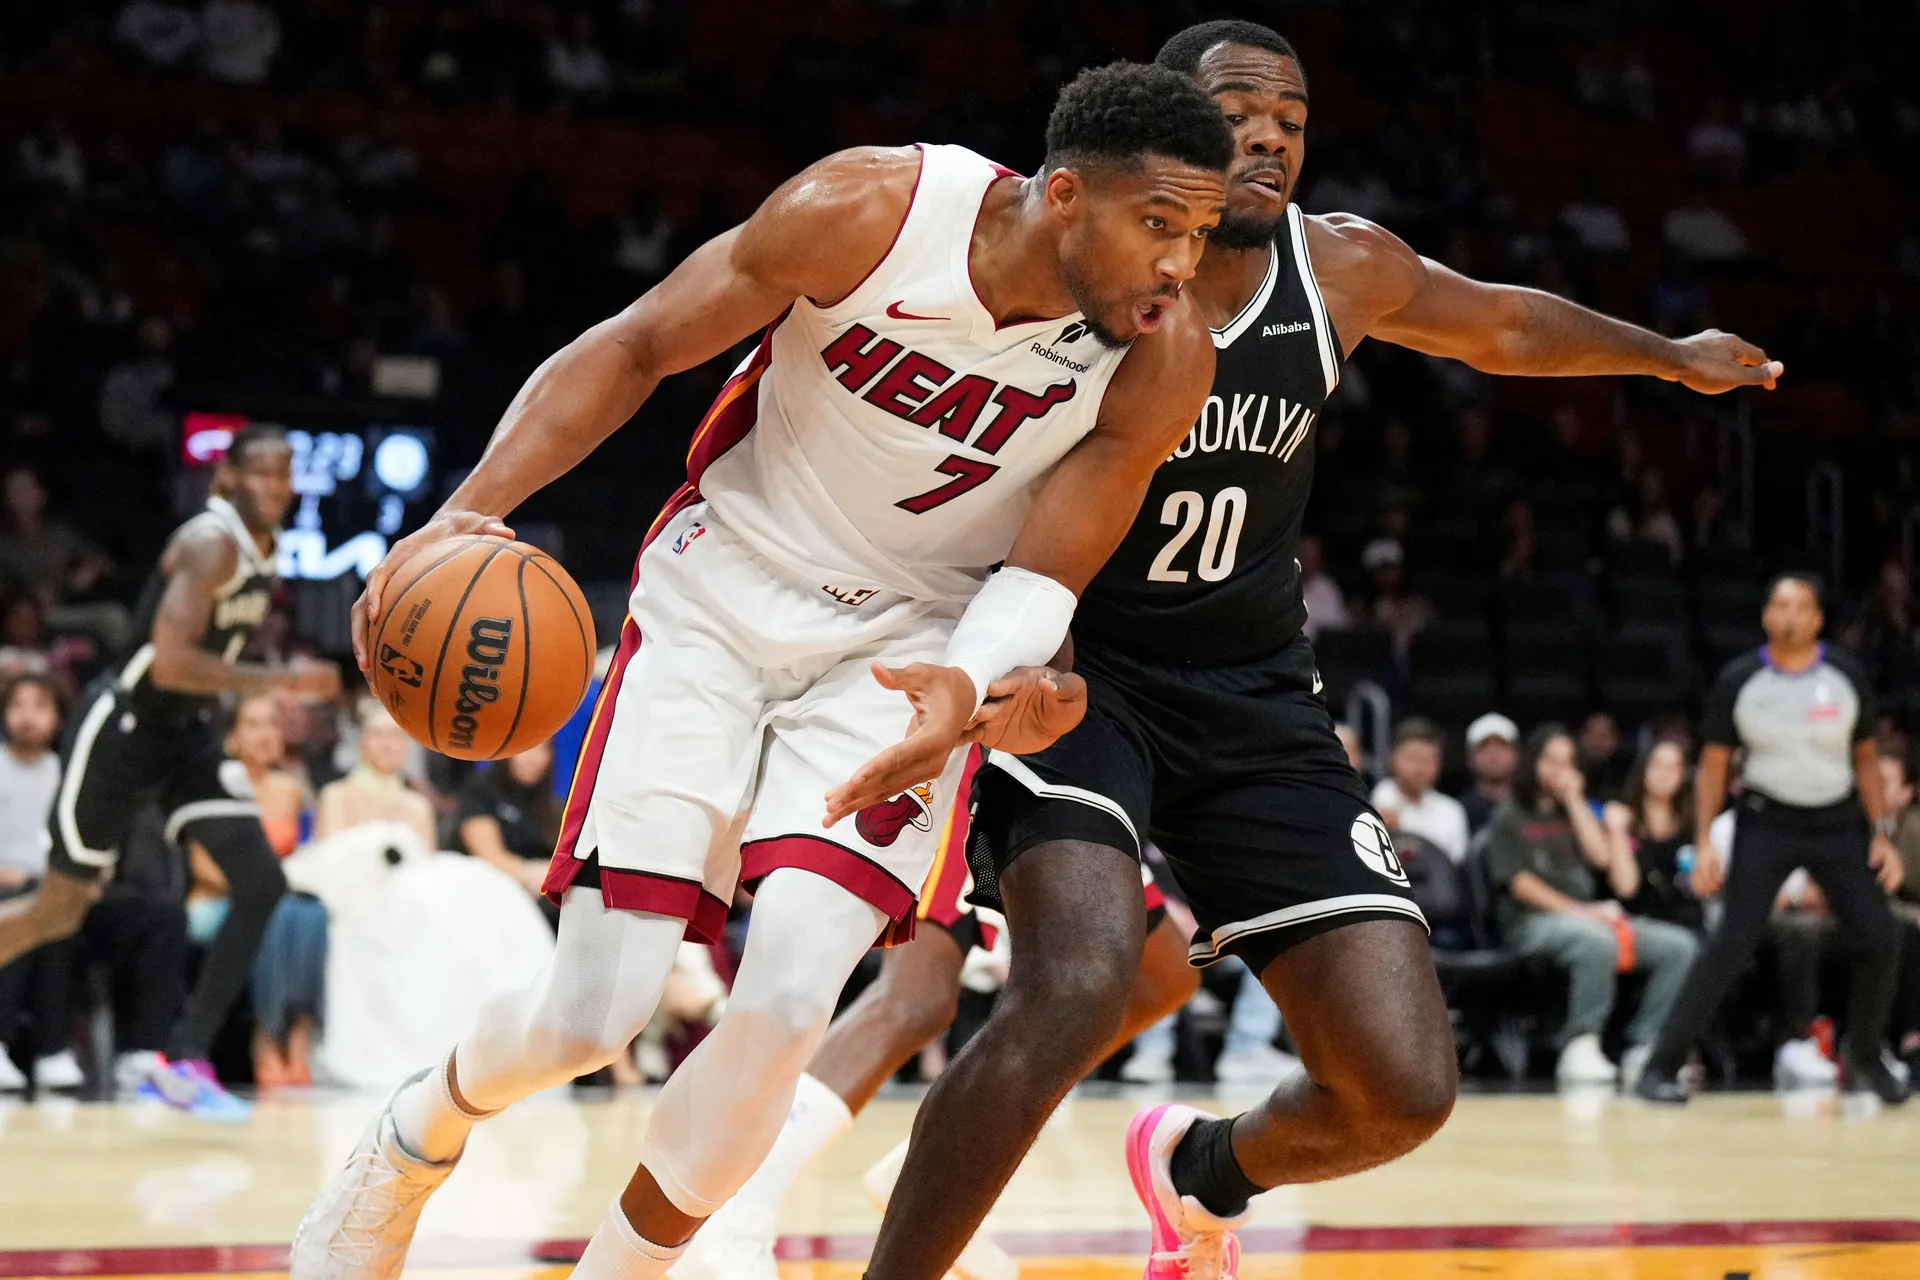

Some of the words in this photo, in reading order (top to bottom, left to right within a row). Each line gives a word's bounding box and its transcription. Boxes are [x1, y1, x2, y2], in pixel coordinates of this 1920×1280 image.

[1030, 342, 1091, 374] Robinhood
[1262, 321, 1311, 337] Alibaba
[820, 322, 1077, 456] HEAT
[1166, 393, 1316, 464] OKLYN
[893, 453, 1001, 515] 7
[1147, 486, 1248, 583] 20
[447, 617, 513, 750] Wilson
